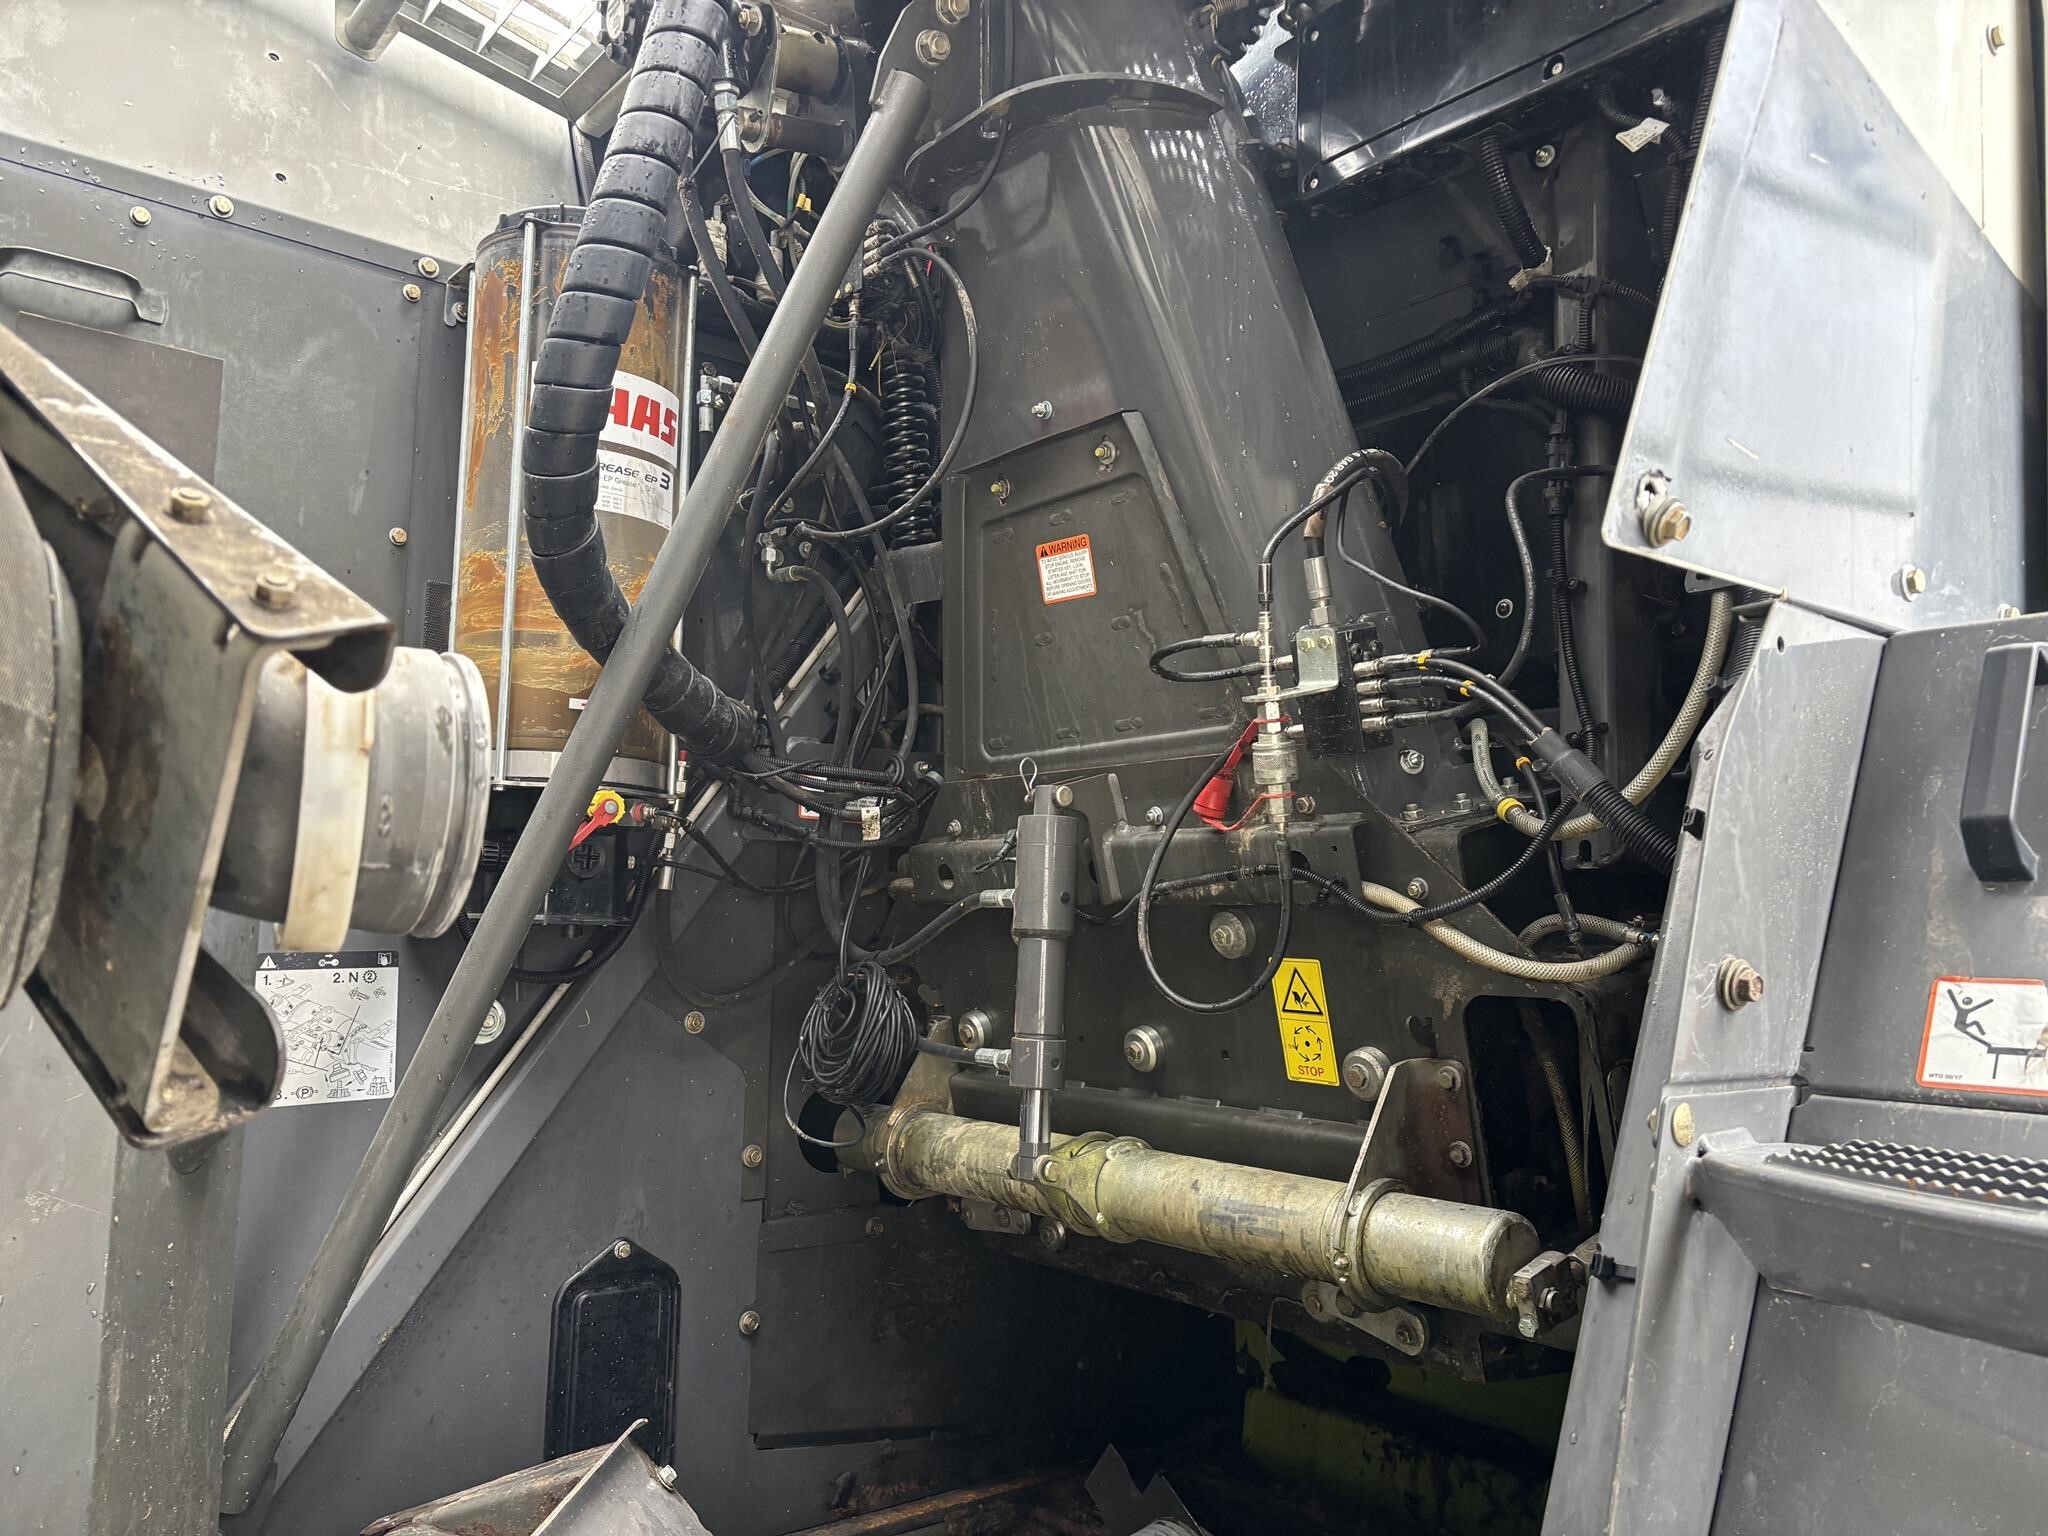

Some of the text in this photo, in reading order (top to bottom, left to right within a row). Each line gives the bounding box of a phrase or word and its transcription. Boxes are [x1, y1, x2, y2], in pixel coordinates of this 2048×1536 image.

[609, 388, 677, 447] AAS
[1334, 456, 1354, 471] BAR
[600, 463, 640, 478] REASE
[645, 474, 658, 483] EP
[660, 472, 670, 490] 3
[1049, 537, 1086, 554] WARNING
[264, 974, 272, 986] 1.
[333, 972, 344, 983] 2.
[349, 972, 358, 982] N
[1298, 1065, 1324, 1076] STOP
